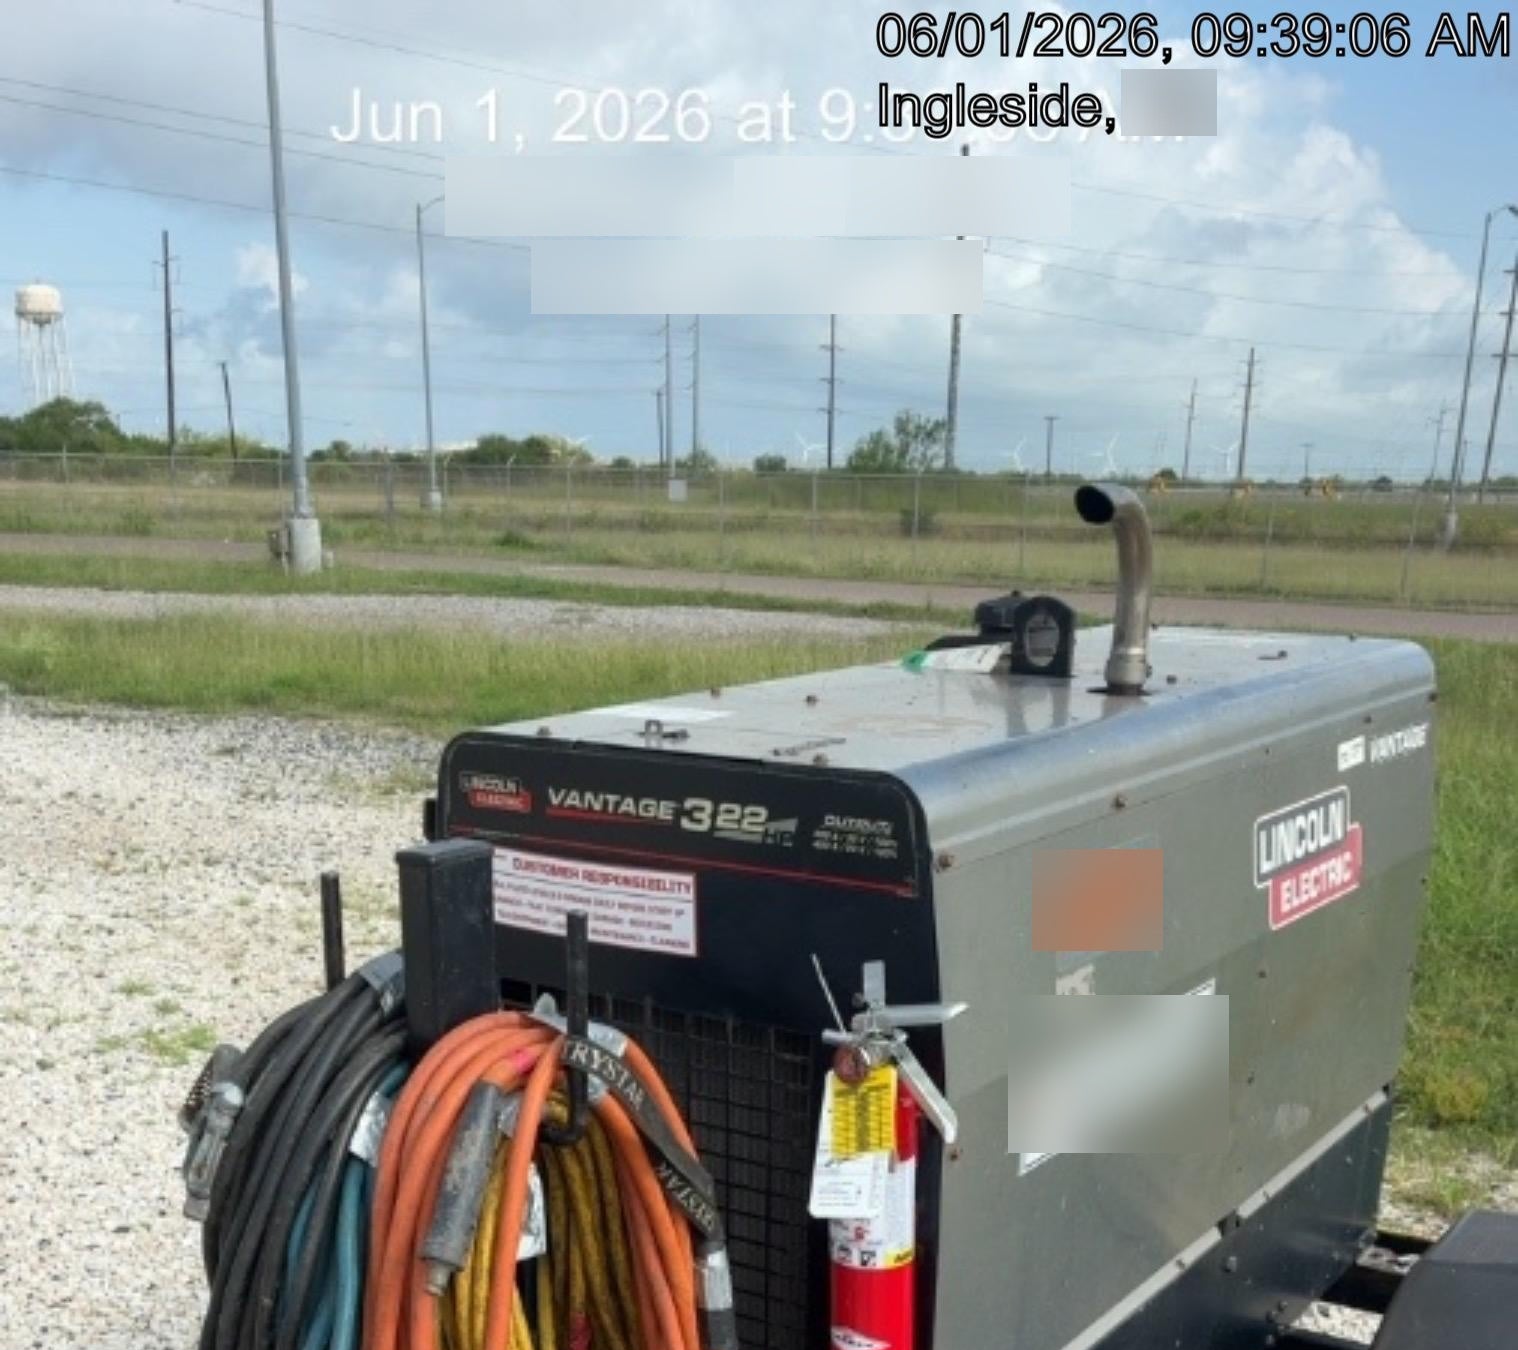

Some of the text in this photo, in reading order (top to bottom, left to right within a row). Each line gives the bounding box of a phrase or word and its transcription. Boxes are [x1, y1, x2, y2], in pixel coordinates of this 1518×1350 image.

[548, 786, 769, 832] VANTAGE 322
[1259, 798, 1345, 874] LINCOLN
[512, 857, 580, 881] CUSTOMER
[581, 869, 691, 894] RESPONSIBILITY
[1280, 851, 1352, 914] ELECTRIC
